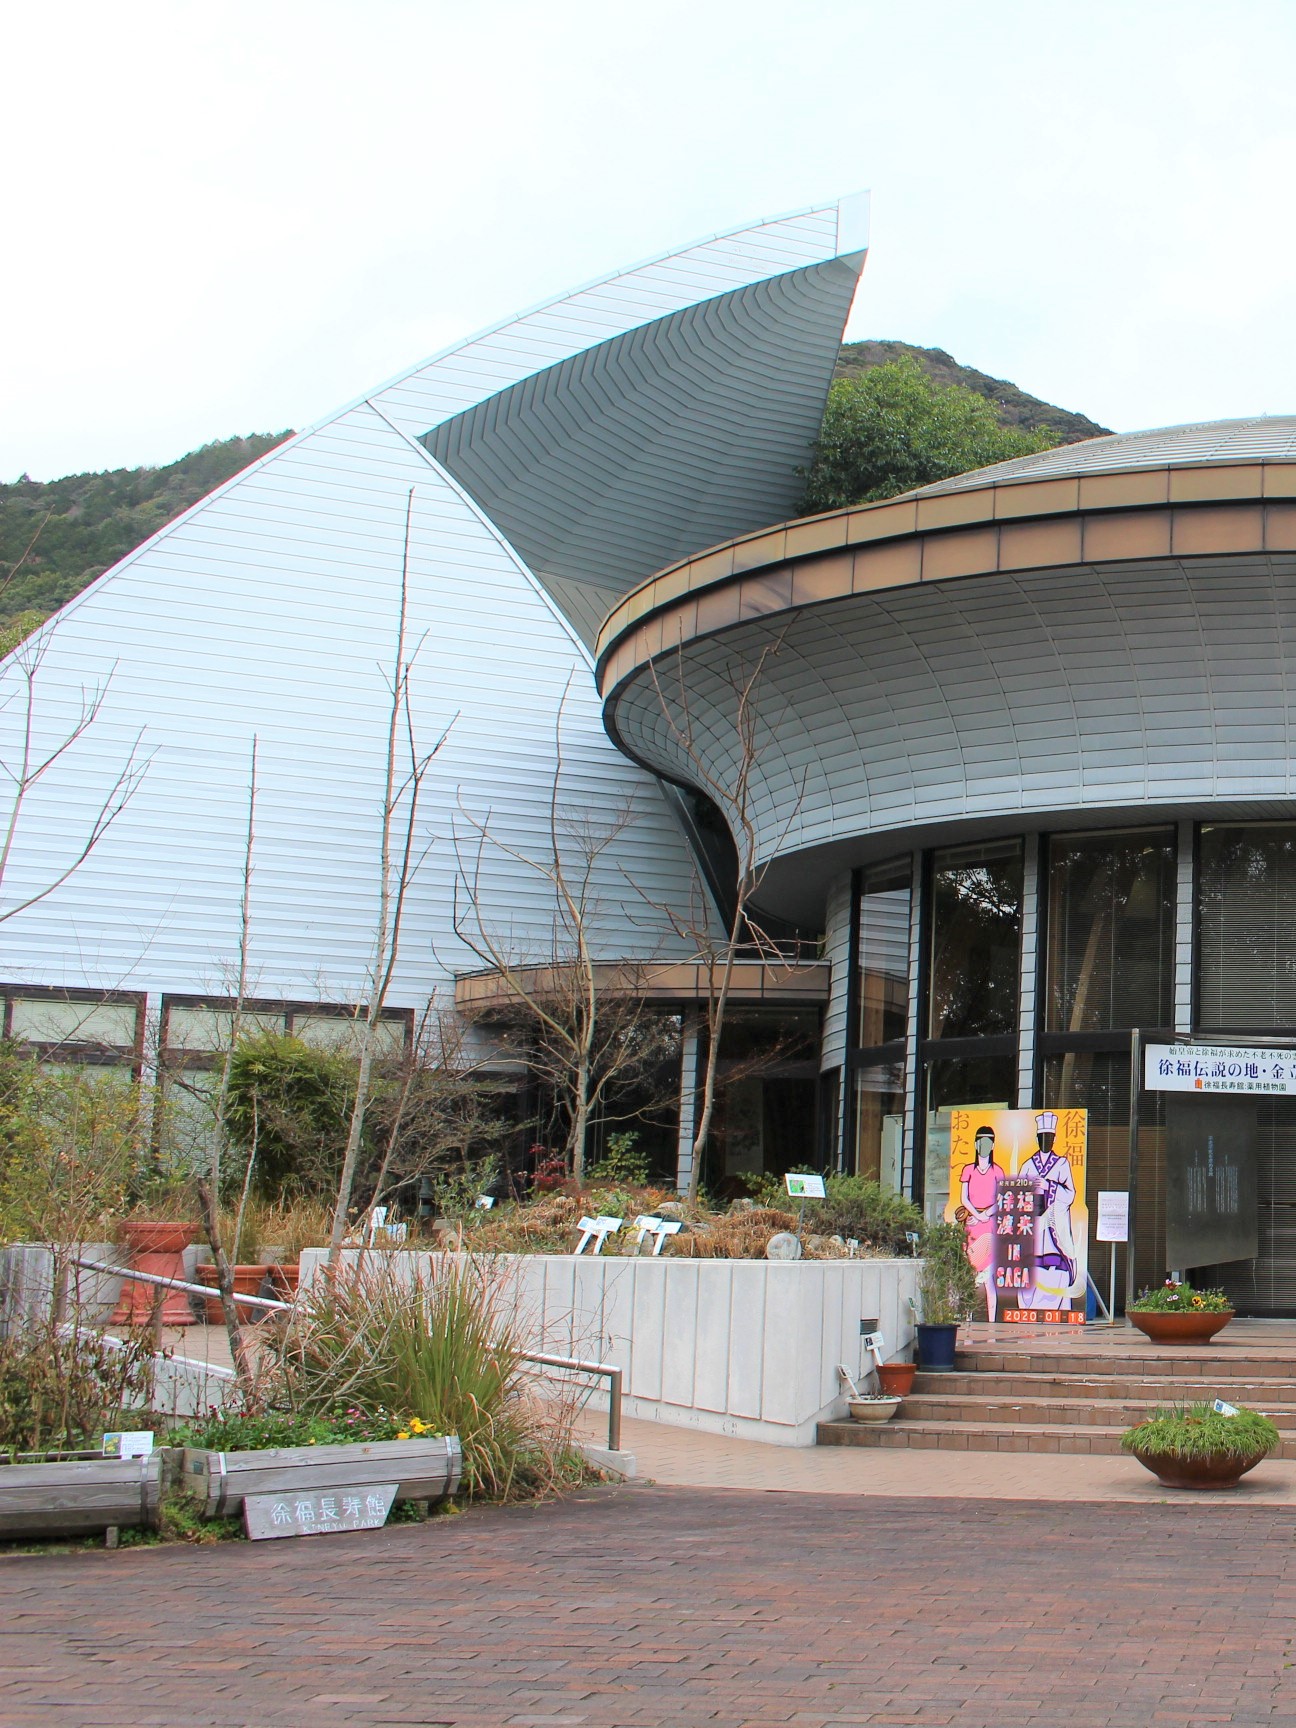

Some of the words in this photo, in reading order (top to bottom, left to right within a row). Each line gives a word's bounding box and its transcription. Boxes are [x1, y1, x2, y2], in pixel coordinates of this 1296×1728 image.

[1062, 1110, 1086, 1168] 徐福
[996, 1190, 1034, 1212] 徐福
[996, 1214, 1034, 1236] 渡来
[1007, 1243, 1021, 1261] IN
[996, 1266, 1031, 1289] SAGA
[1006, 1310, 1085, 1322] 2020-01-18
[270, 1494, 386, 1525] 徐福長寿館
[353, 1518, 381, 1528] PARK
